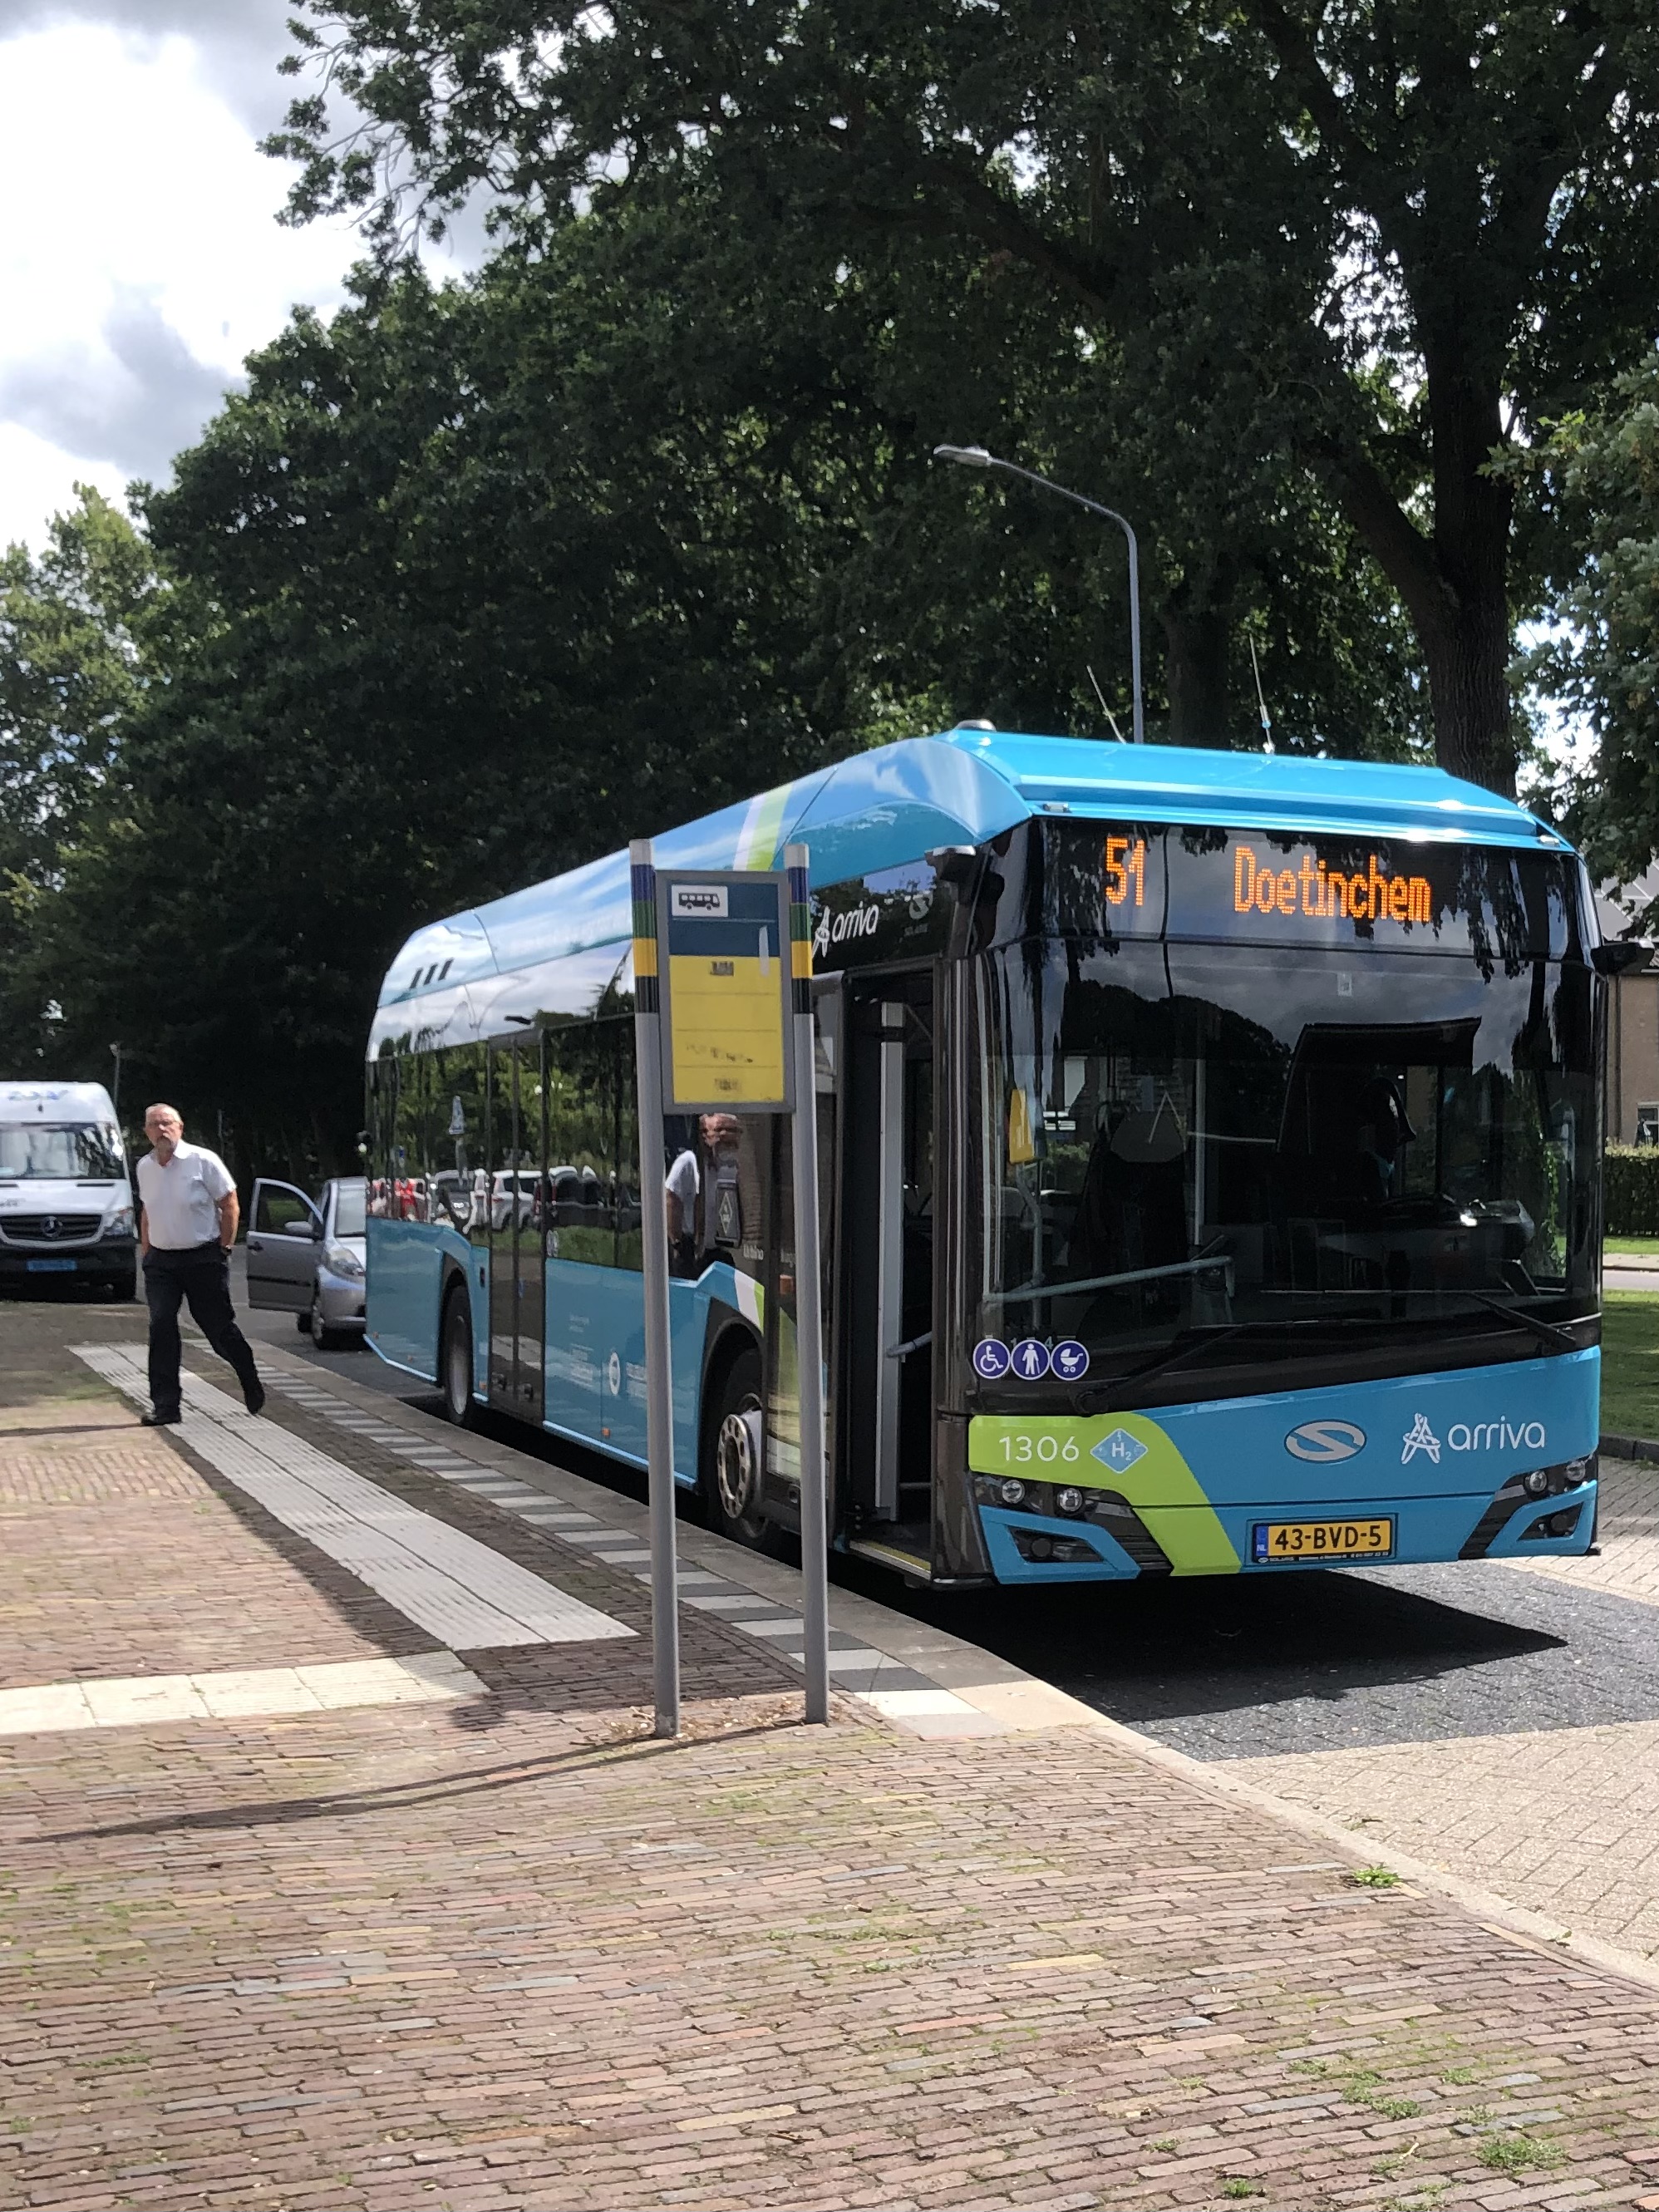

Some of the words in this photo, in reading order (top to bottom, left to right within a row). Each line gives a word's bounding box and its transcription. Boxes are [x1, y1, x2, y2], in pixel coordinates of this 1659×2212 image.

[1105, 835, 1145, 907] 51
[1233, 845, 1432, 924] Doetinchem
[832, 900, 879, 943] arriva
[998, 1436, 1080, 1462] 1306
[1447, 1415, 1546, 1451] arriva
[1274, 1525, 1381, 1551] 43-BVD-5
